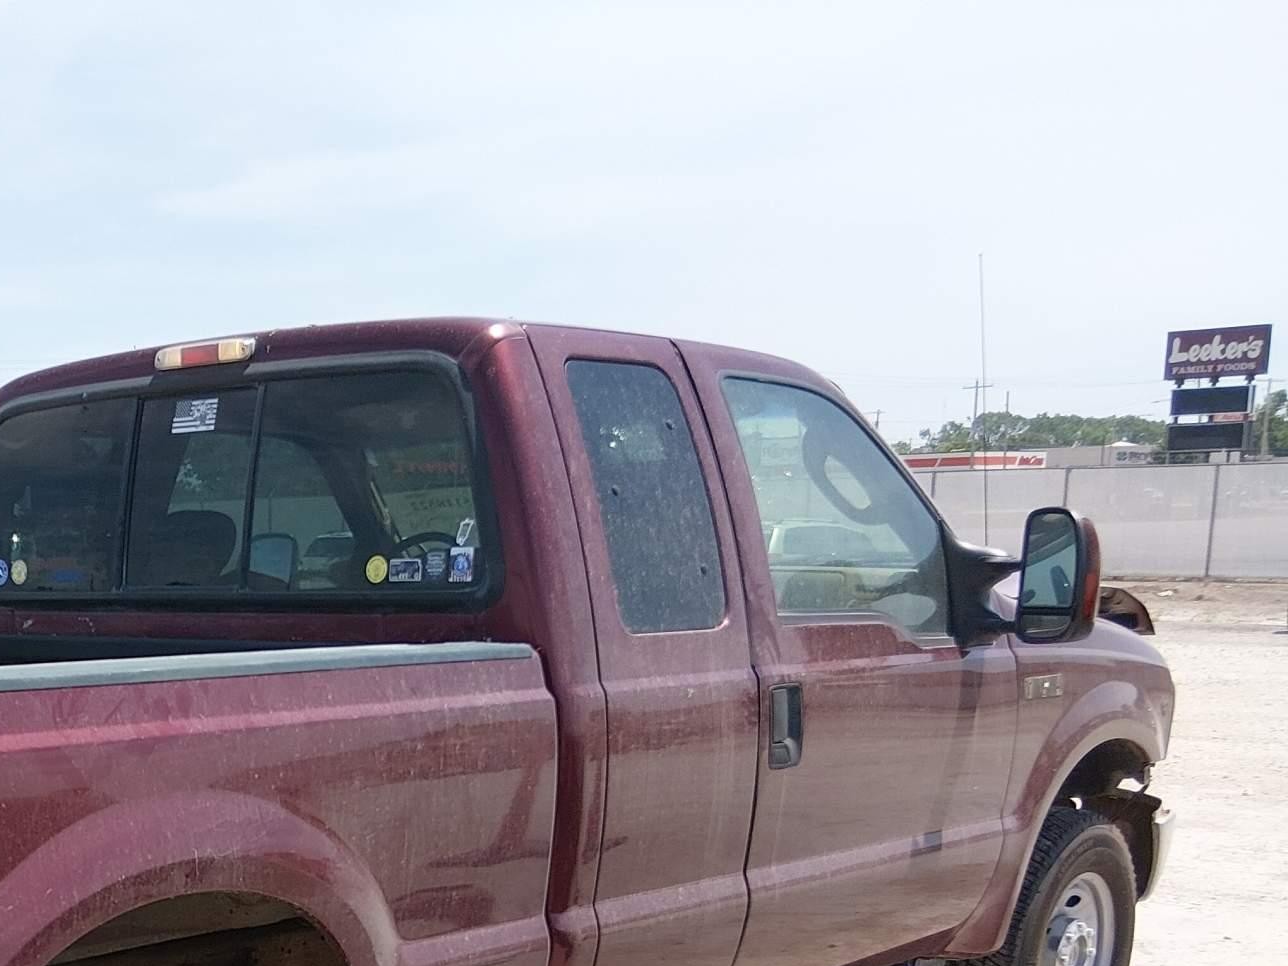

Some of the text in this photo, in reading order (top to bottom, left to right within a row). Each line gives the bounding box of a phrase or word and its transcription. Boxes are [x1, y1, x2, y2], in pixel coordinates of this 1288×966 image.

[1168, 334, 1264, 364] Leeker's
[1172, 362, 1257, 375] FAMILY FOODS
